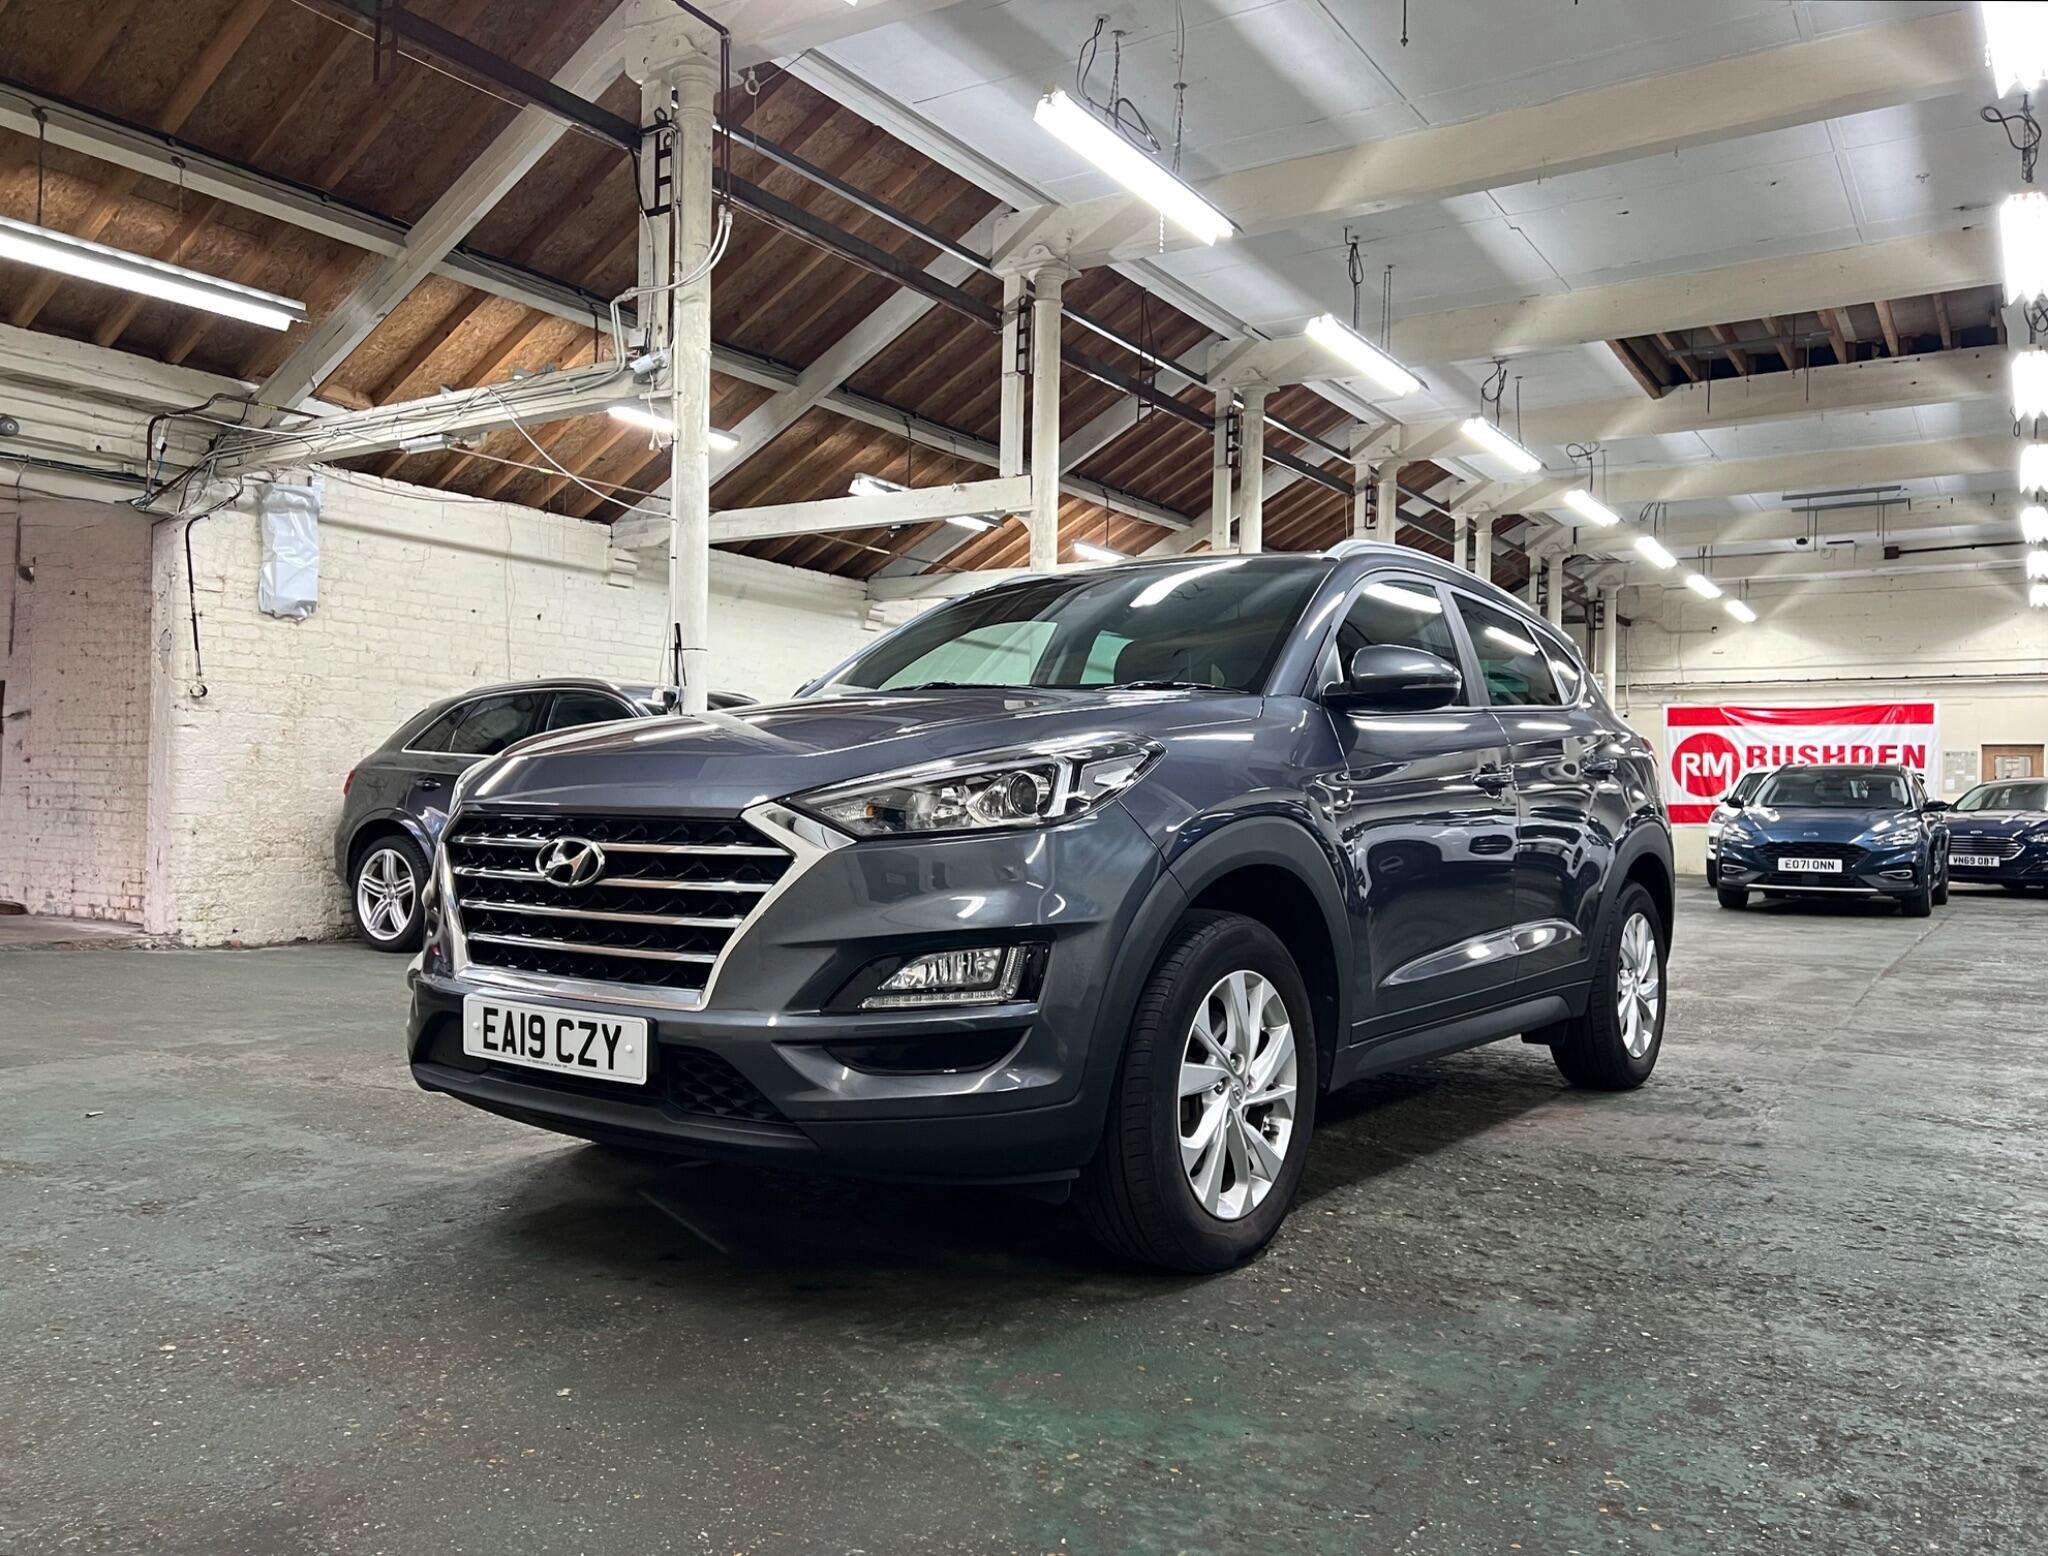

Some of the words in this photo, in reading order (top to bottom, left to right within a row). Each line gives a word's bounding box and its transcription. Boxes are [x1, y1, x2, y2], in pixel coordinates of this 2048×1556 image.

[1681, 752, 1733, 790] RM
[1746, 744, 1926, 769] RUSHDEN
[1812, 860, 1835, 870] ONN
[1953, 856, 1976, 865] VN69
[483, 1007, 545, 1059] EA19
[556, 1018, 622, 1070] CZY
